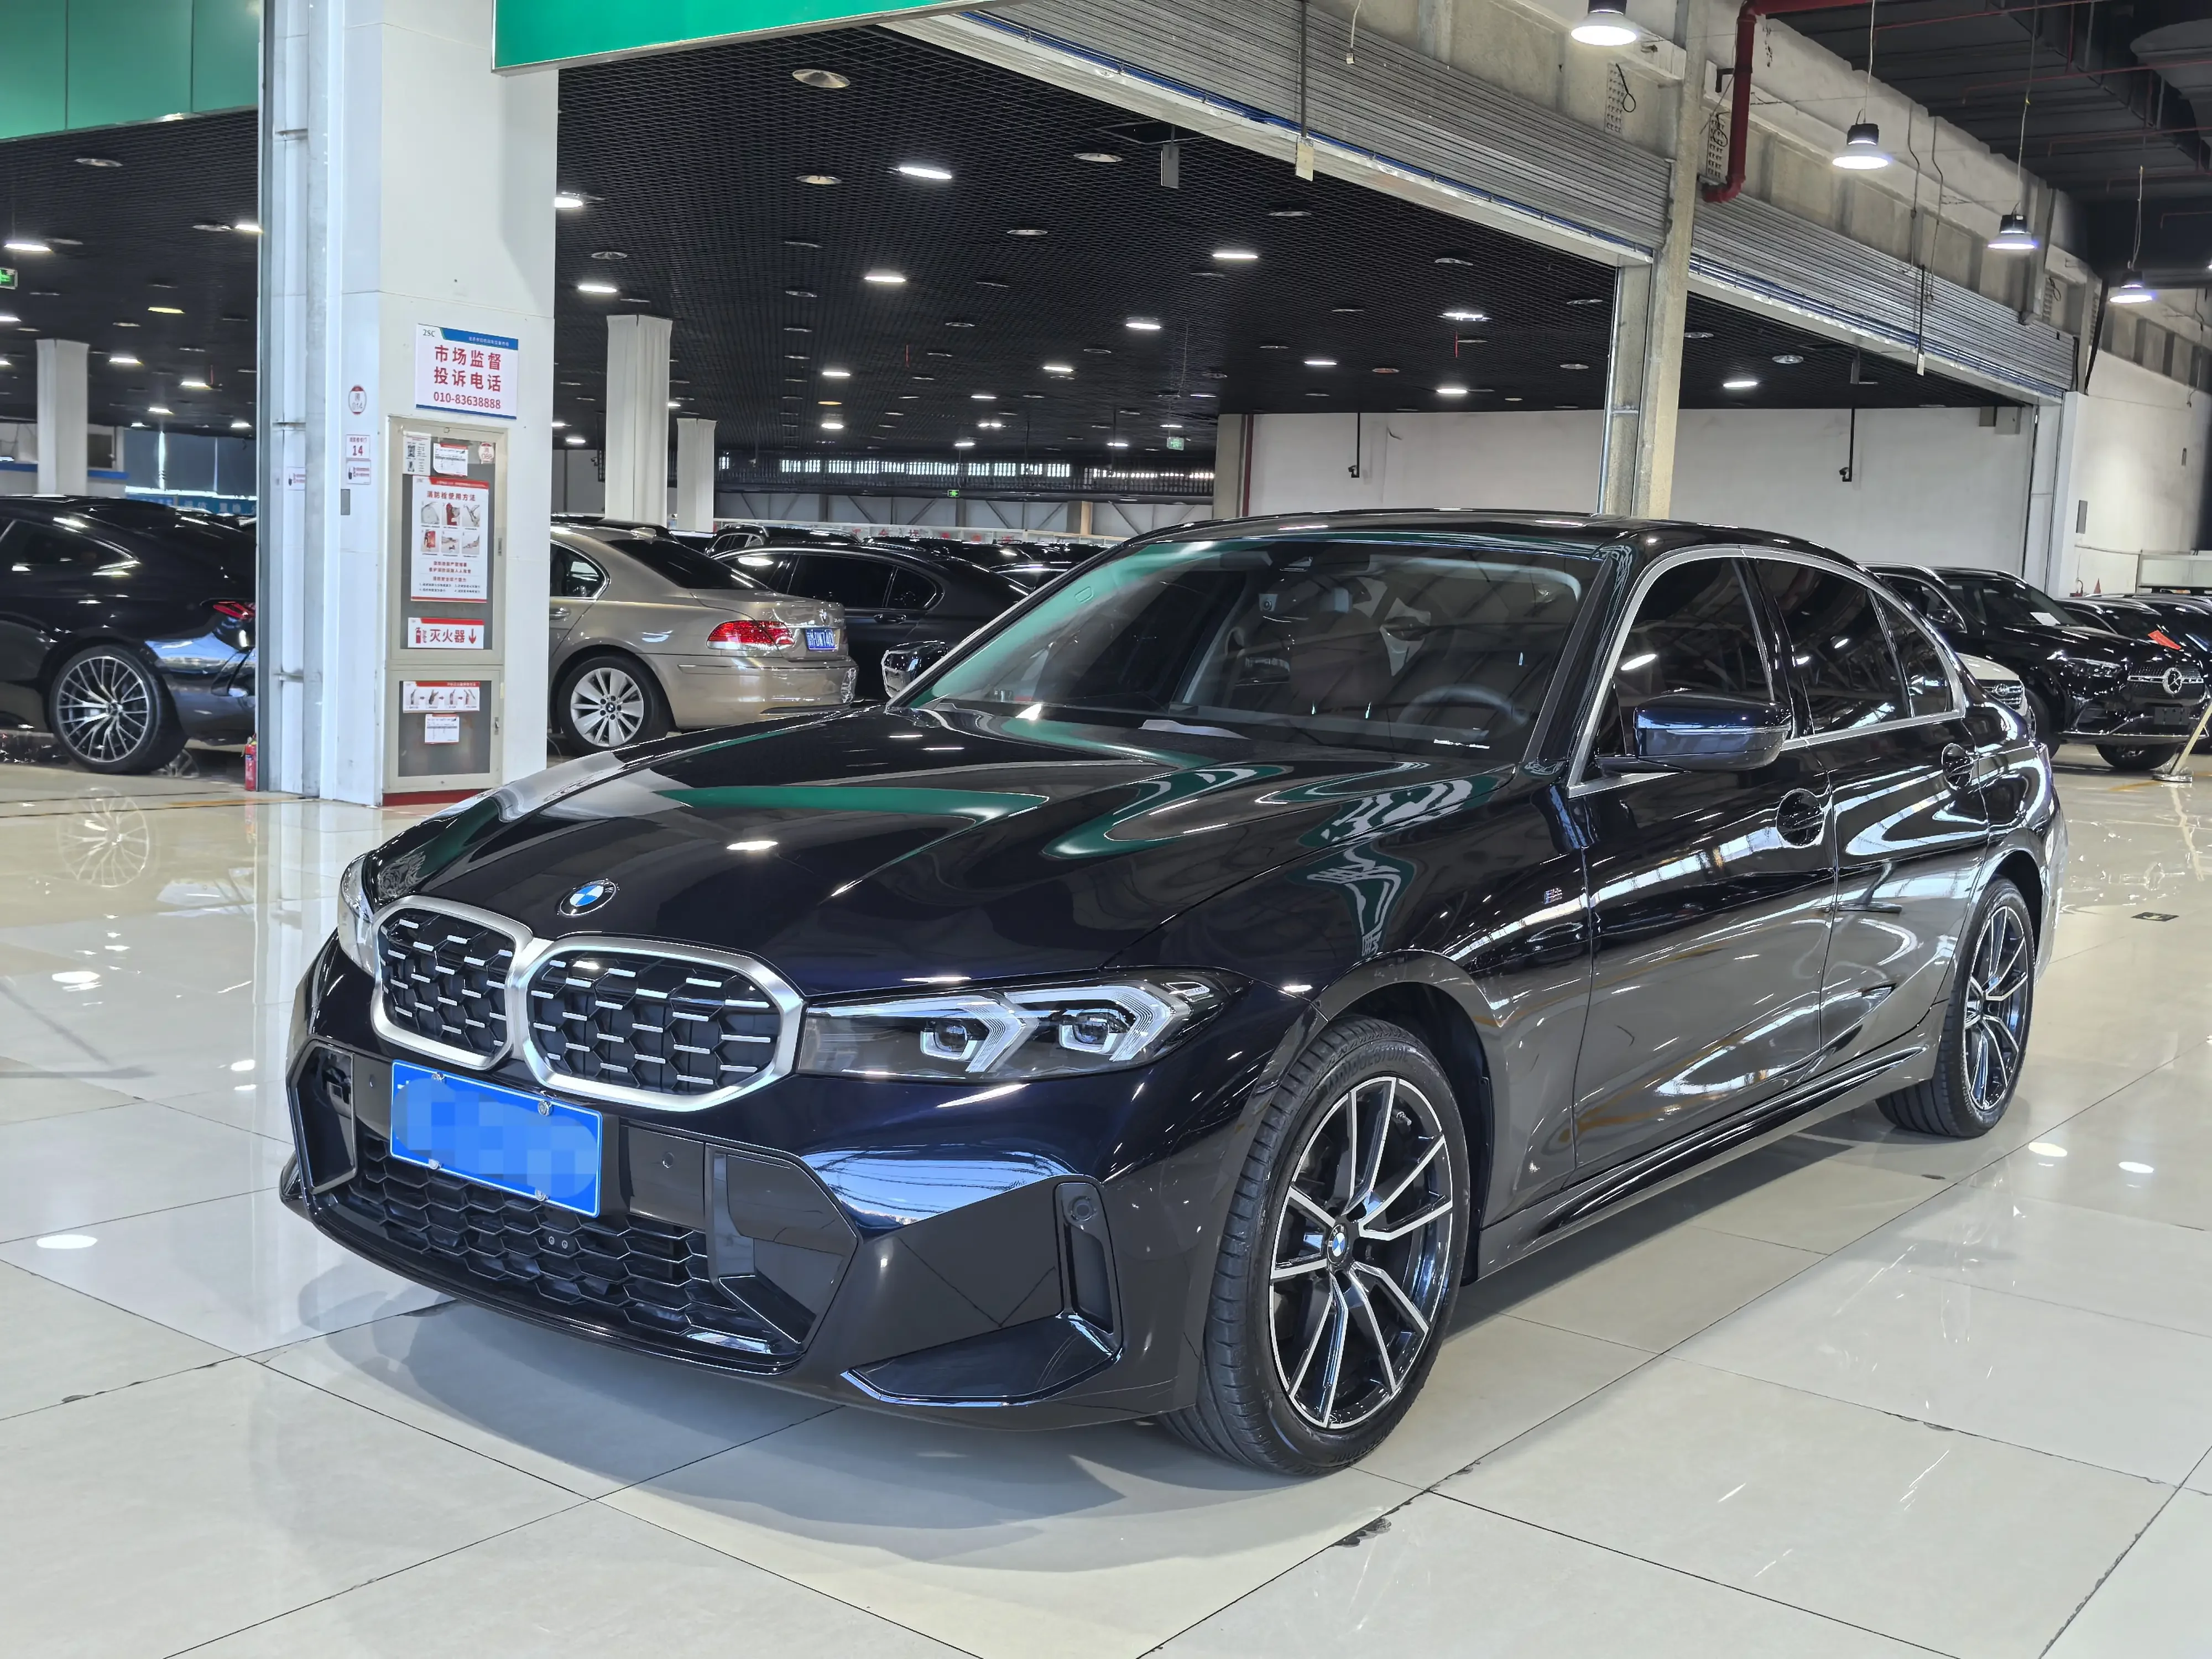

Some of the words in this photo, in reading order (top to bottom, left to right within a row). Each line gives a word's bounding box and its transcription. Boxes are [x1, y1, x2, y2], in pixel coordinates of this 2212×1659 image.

[434, 345, 501, 371] 市场监督
[434, 366, 502, 392] 投诉电话
[434, 392, 501, 409] 010-83638888
[353, 445, 363, 456] 14
[429, 629, 465, 644] 灭火器
